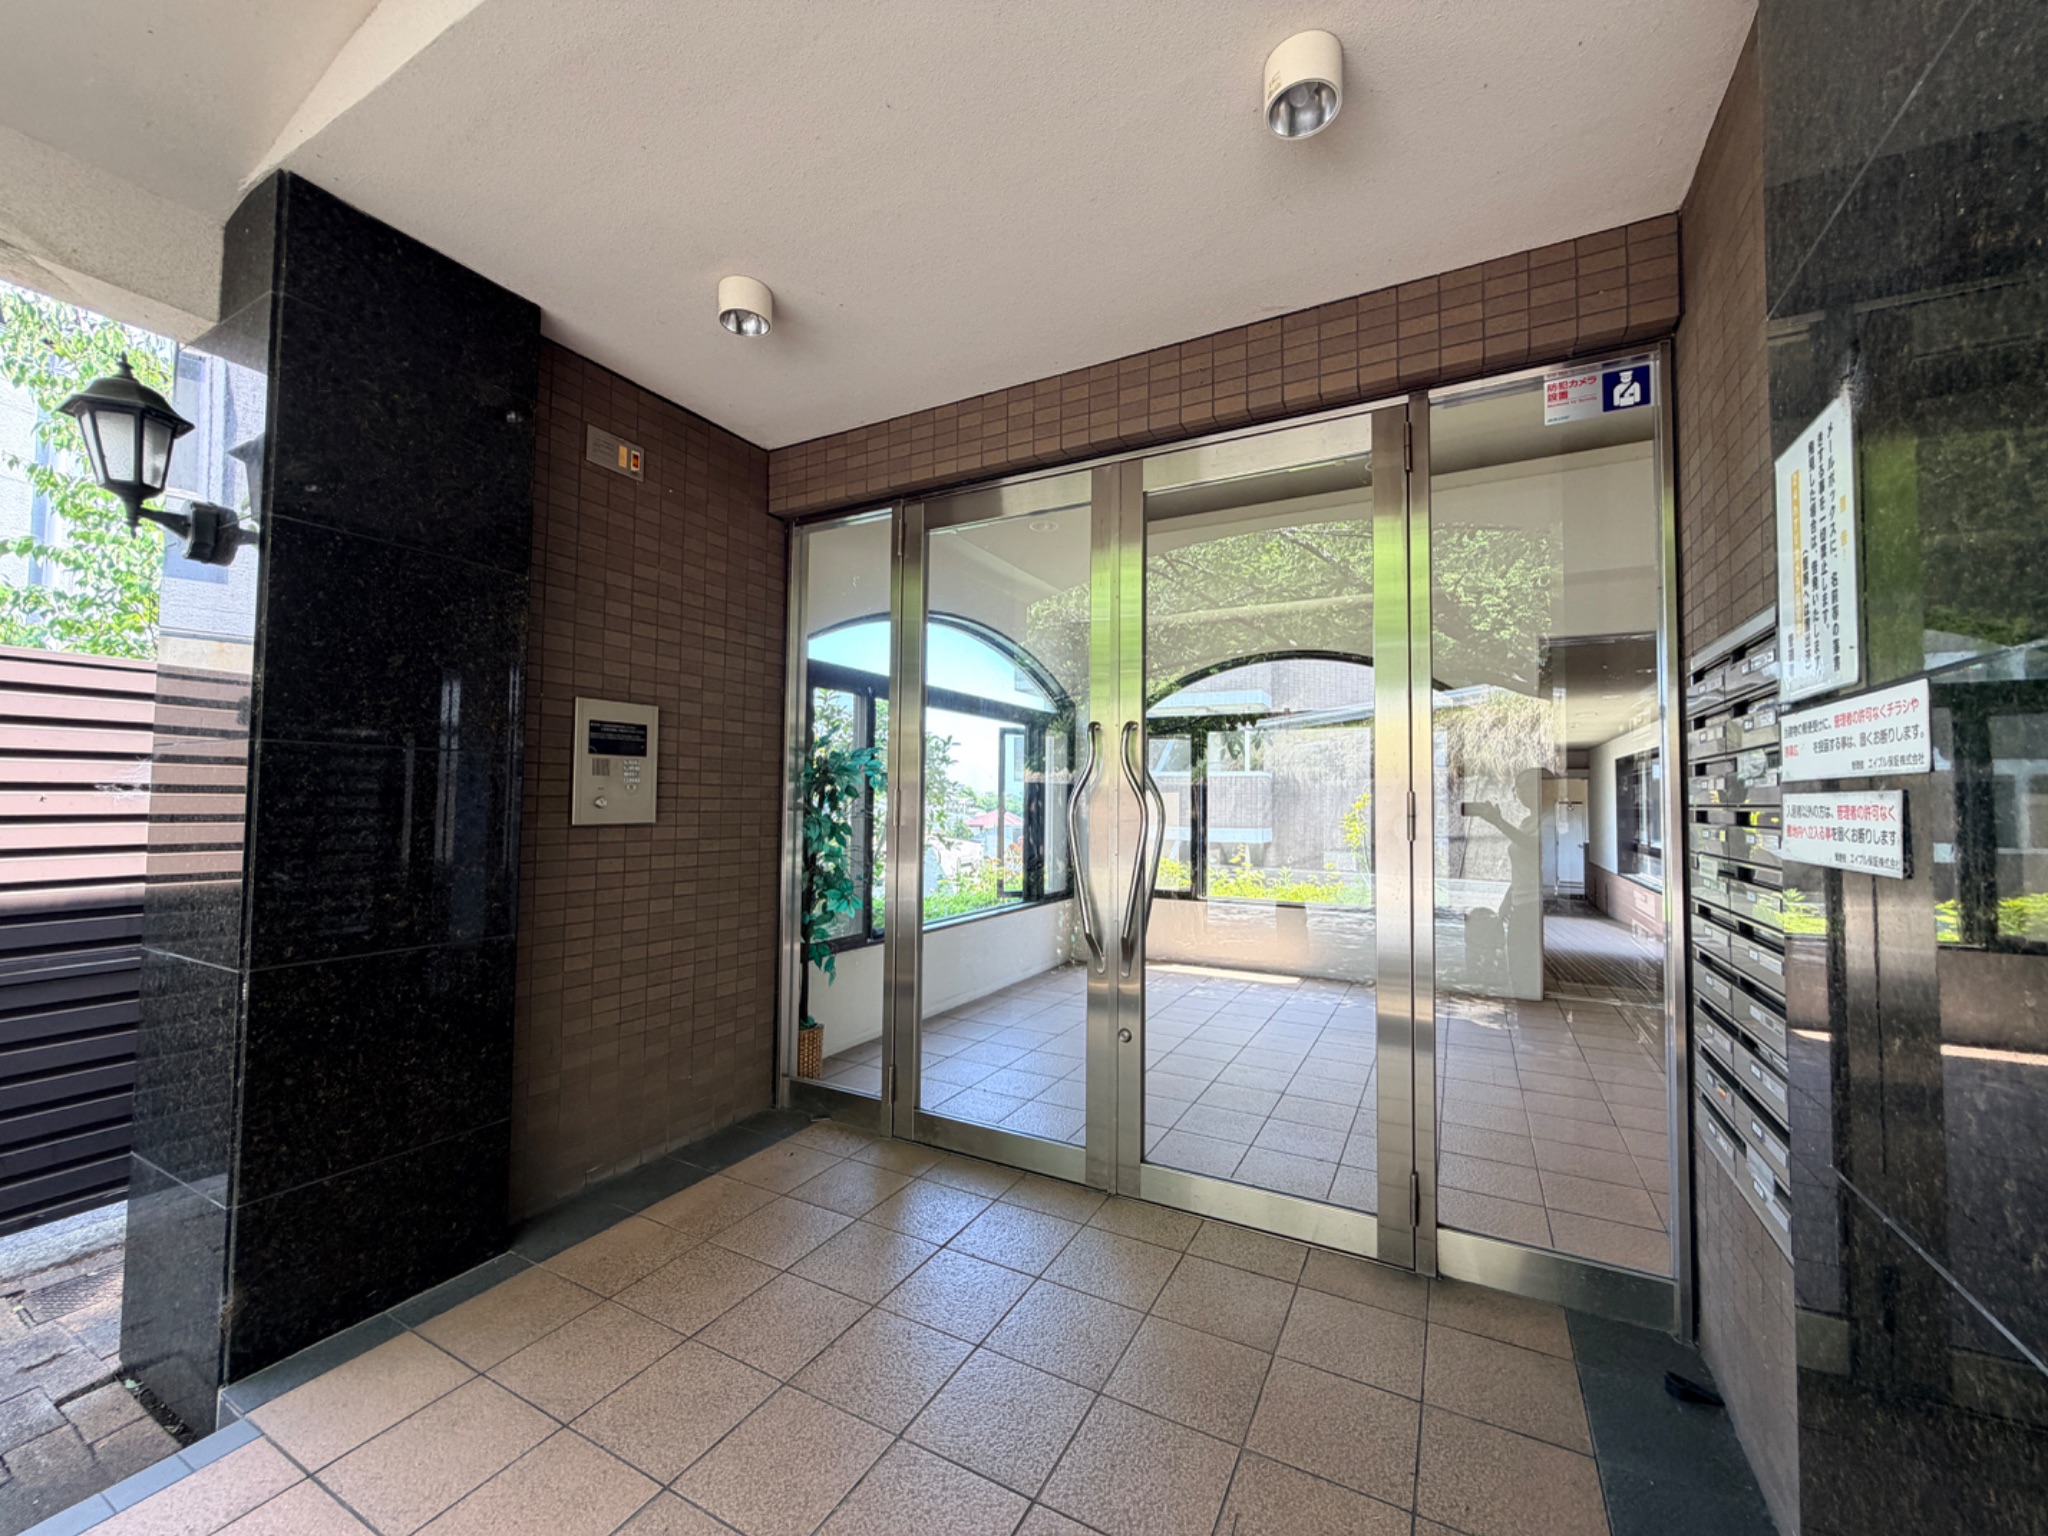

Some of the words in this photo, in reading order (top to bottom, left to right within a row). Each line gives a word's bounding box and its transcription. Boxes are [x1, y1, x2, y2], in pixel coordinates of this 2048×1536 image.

[1547, 376, 1597, 393] 防犯カメラ
[1547, 391, 1568, 403] 設置
